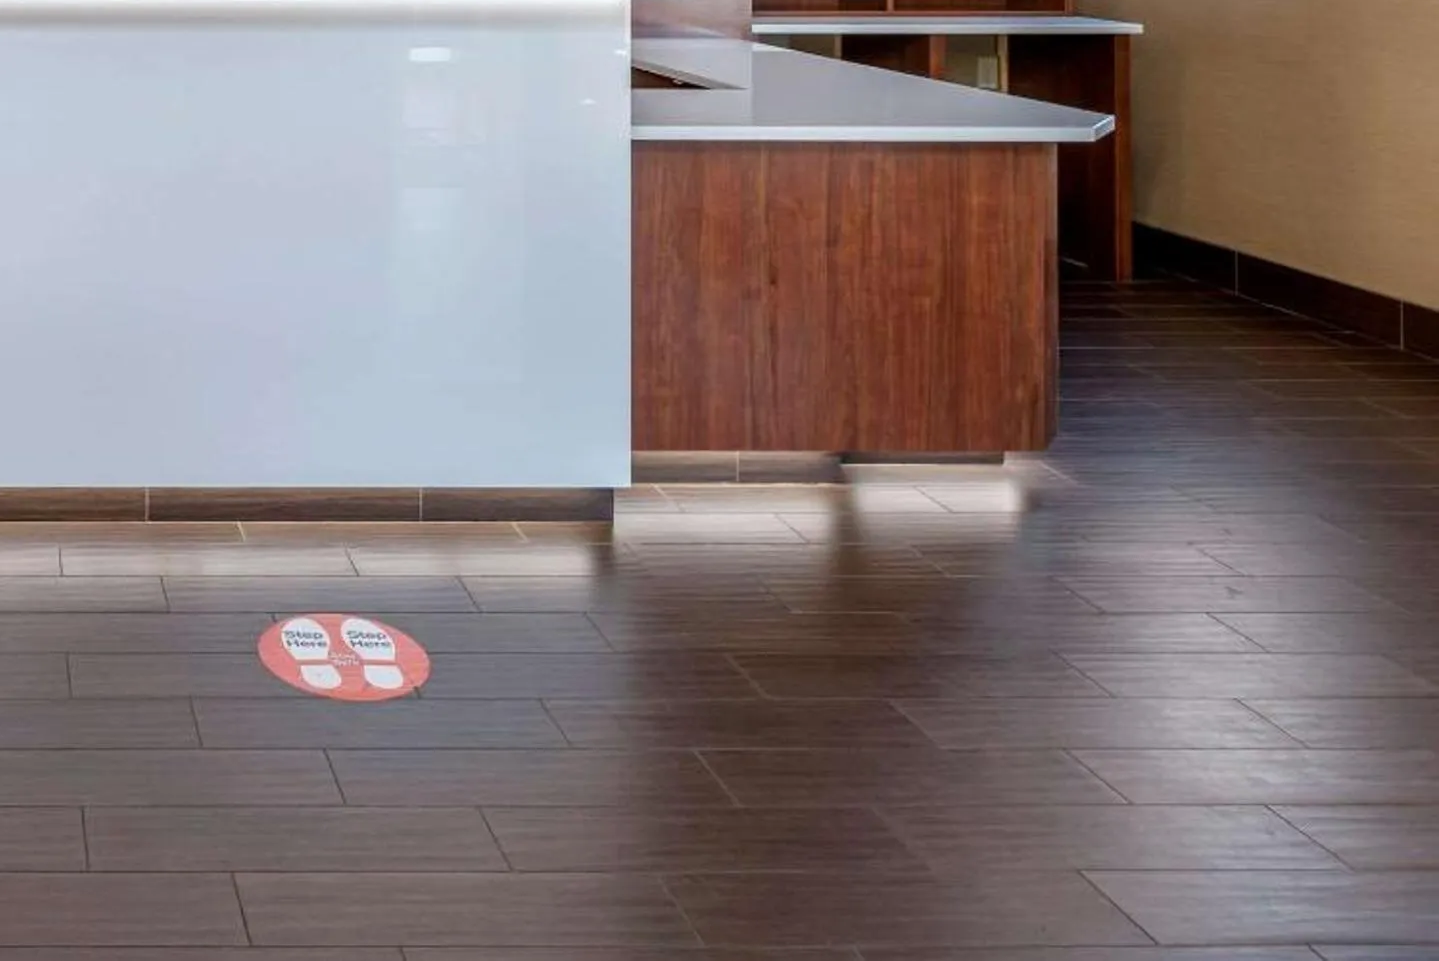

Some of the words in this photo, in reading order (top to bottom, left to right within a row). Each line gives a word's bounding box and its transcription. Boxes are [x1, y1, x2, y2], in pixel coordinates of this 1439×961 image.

[284, 630, 324, 639] Step
[346, 630, 387, 639] Step
[286, 638, 328, 647] Here
[349, 638, 391, 647] Here
